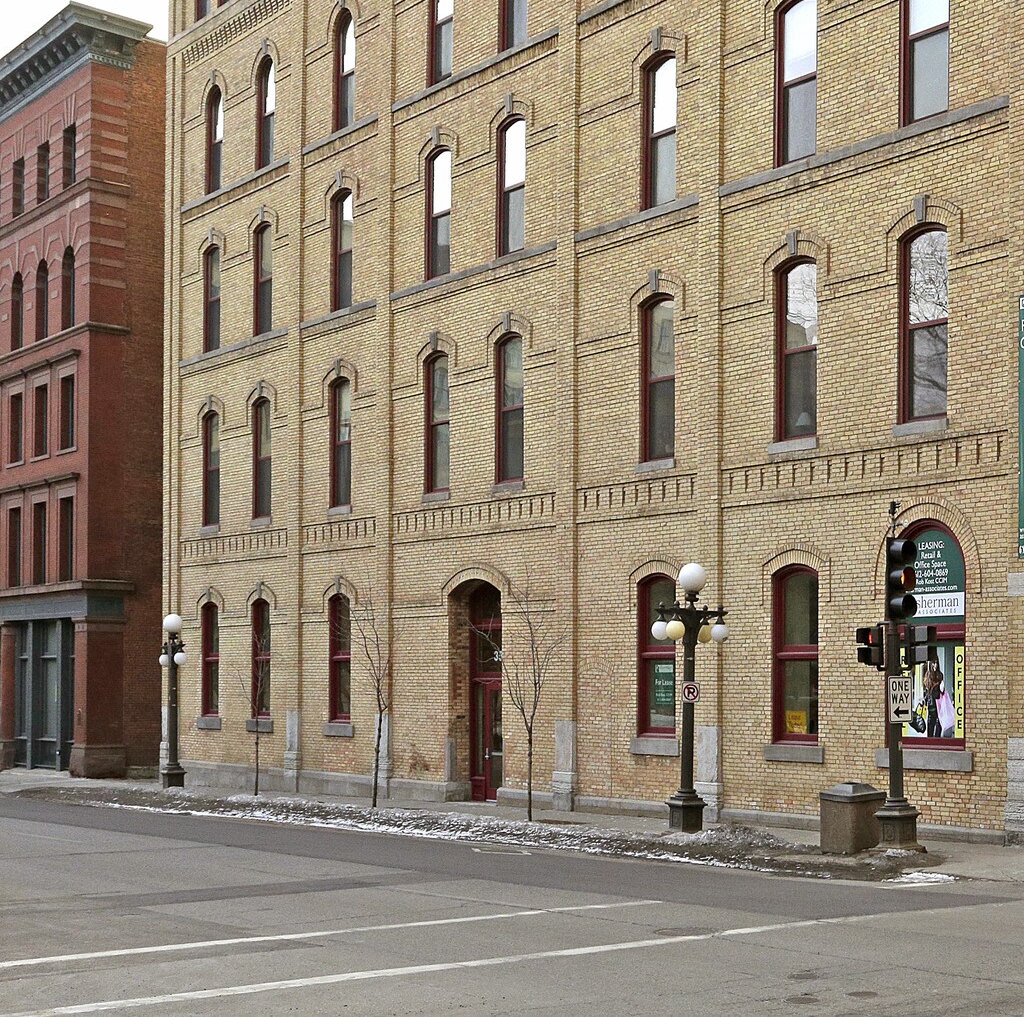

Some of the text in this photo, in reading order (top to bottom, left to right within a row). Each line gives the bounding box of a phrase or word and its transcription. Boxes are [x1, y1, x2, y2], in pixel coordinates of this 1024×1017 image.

[918, 541, 945, 551] LEASING:
[931, 560, 947, 569] Space
[917, 596, 960, 609] sherman
[891, 680, 909, 692] ONE
[891, 693, 910, 704] WAY
